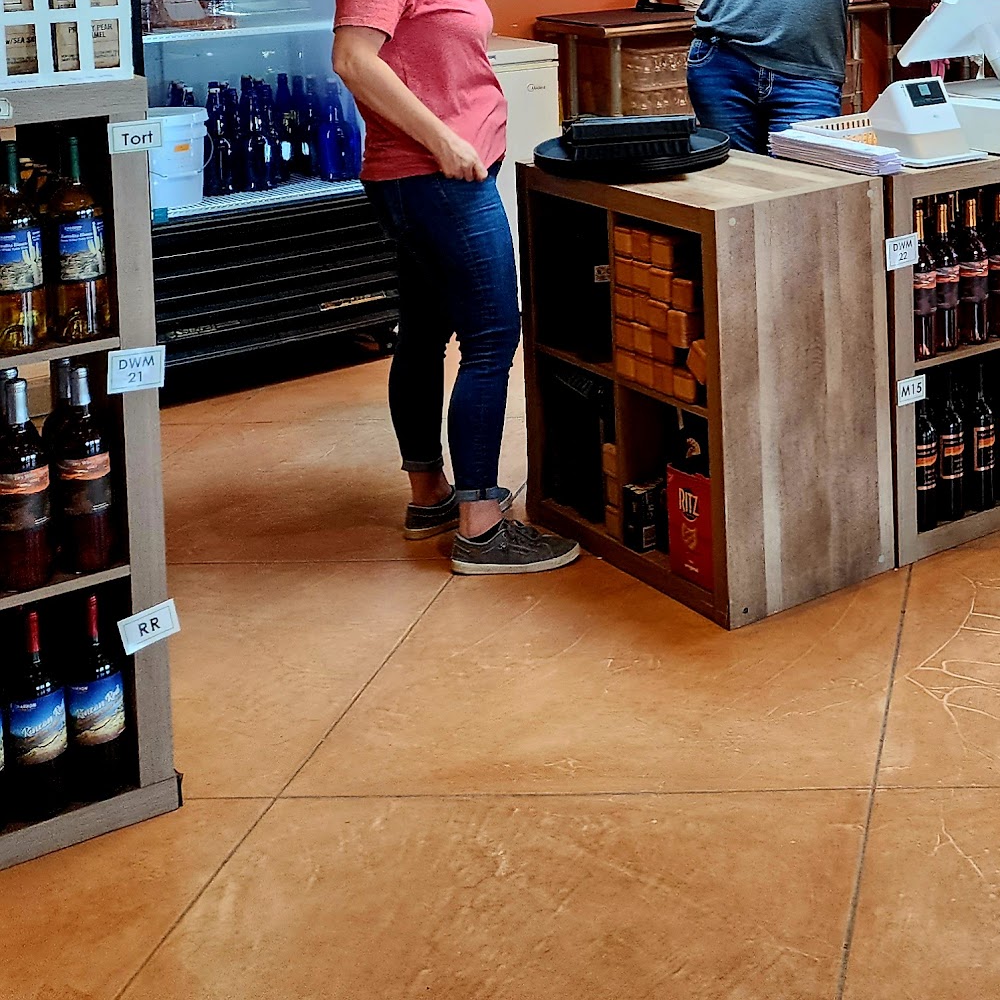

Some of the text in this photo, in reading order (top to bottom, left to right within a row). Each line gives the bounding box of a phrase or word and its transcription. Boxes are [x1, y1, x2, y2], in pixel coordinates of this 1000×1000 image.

[121, 130, 153, 146] Tort
[893, 240, 913, 251] DWM
[899, 251, 908, 261] 22
[119, 355, 155, 370] DWM
[128, 371, 142, 383] 21
[901, 381, 922, 398] M15
[678, 487, 700, 516] RITZ
[138, 617, 161, 637] RR
